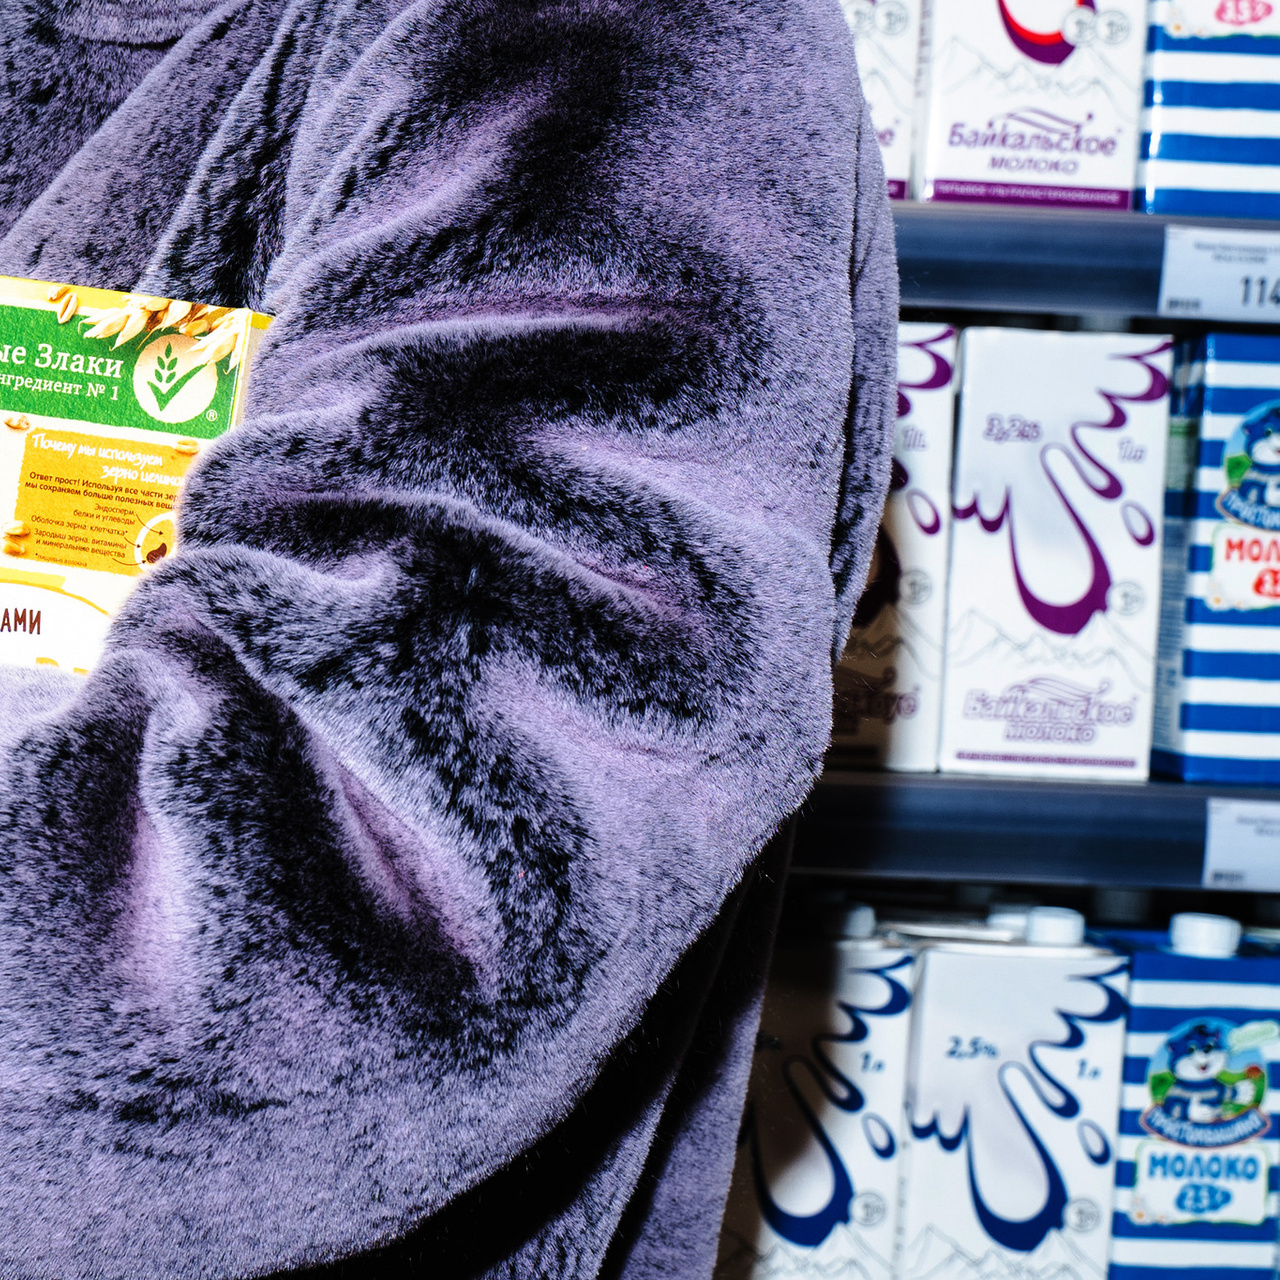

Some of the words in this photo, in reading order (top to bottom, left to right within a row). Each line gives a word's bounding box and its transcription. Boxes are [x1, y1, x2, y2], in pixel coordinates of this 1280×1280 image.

[948, 120, 1117, 157] Байкальское
[988, 155, 1079, 175] молоко
[35, 343, 124, 379] Злаки
[87, 381, 106, 395] №
[111, 386, 119, 401] 1
[32, 432, 77, 460] Почему
[78, 445, 96, 456] мы
[98, 449, 163, 470] используем
[29, 471, 53, 483] Ответ
[54, 476, 80, 487] прост!
[81, 479, 123, 493] Используя
[124, 487, 138, 495] все
[140, 490, 164, 499] части
[100, 465, 138, 485] зерно
[25, 481, 37, 489] мы
[39, 484, 81, 496] сохраняем
[82, 489, 114, 501] больше
[115, 494, 154, 508] полезных
[31, 514, 65, 527] Оболочка
[73, 509, 94, 519] белки
[102, 515, 136, 525] углеводы
[34, 528, 67, 541] Зародыш
[91, 538, 128, 550] витамины
[42, 540, 91, 554] минеральные
[91, 547, 126, 558] вещества
[945, 1036, 1000, 1061] 2,5%
[1148, 1154, 1259, 1181] МОЛОКО
